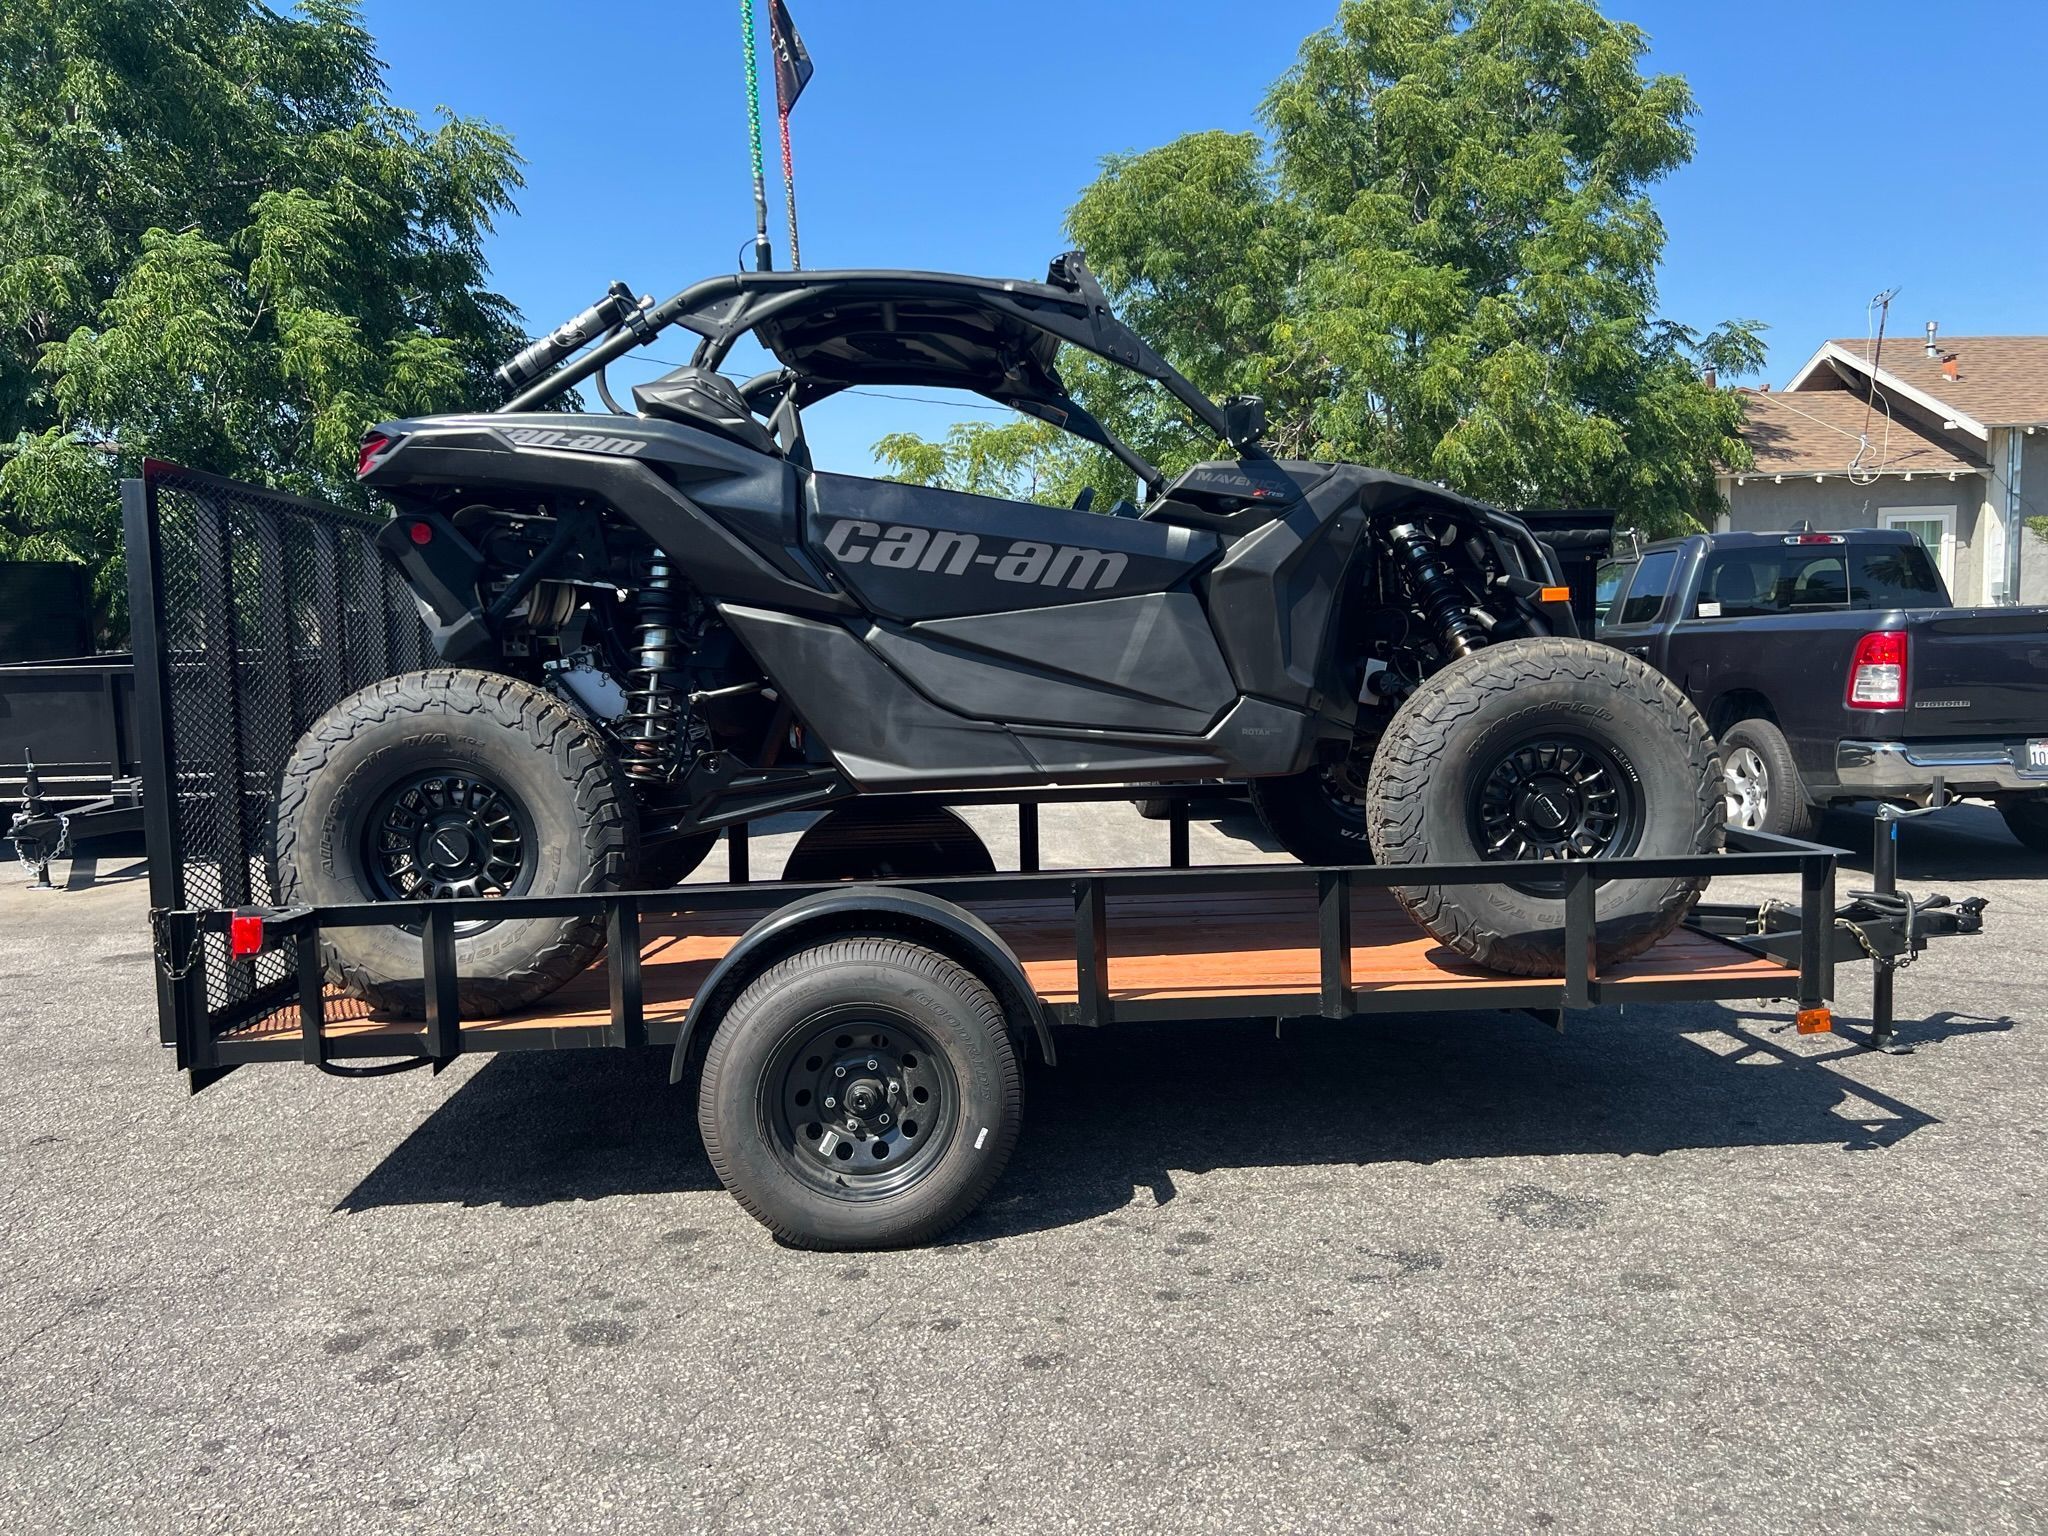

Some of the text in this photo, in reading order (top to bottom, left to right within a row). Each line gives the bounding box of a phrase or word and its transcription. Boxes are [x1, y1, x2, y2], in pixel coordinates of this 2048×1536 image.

[1196, 471, 1288, 489] MAVERICK
[824, 519, 1129, 590] can-am
[402, 733, 449, 747] T/A
